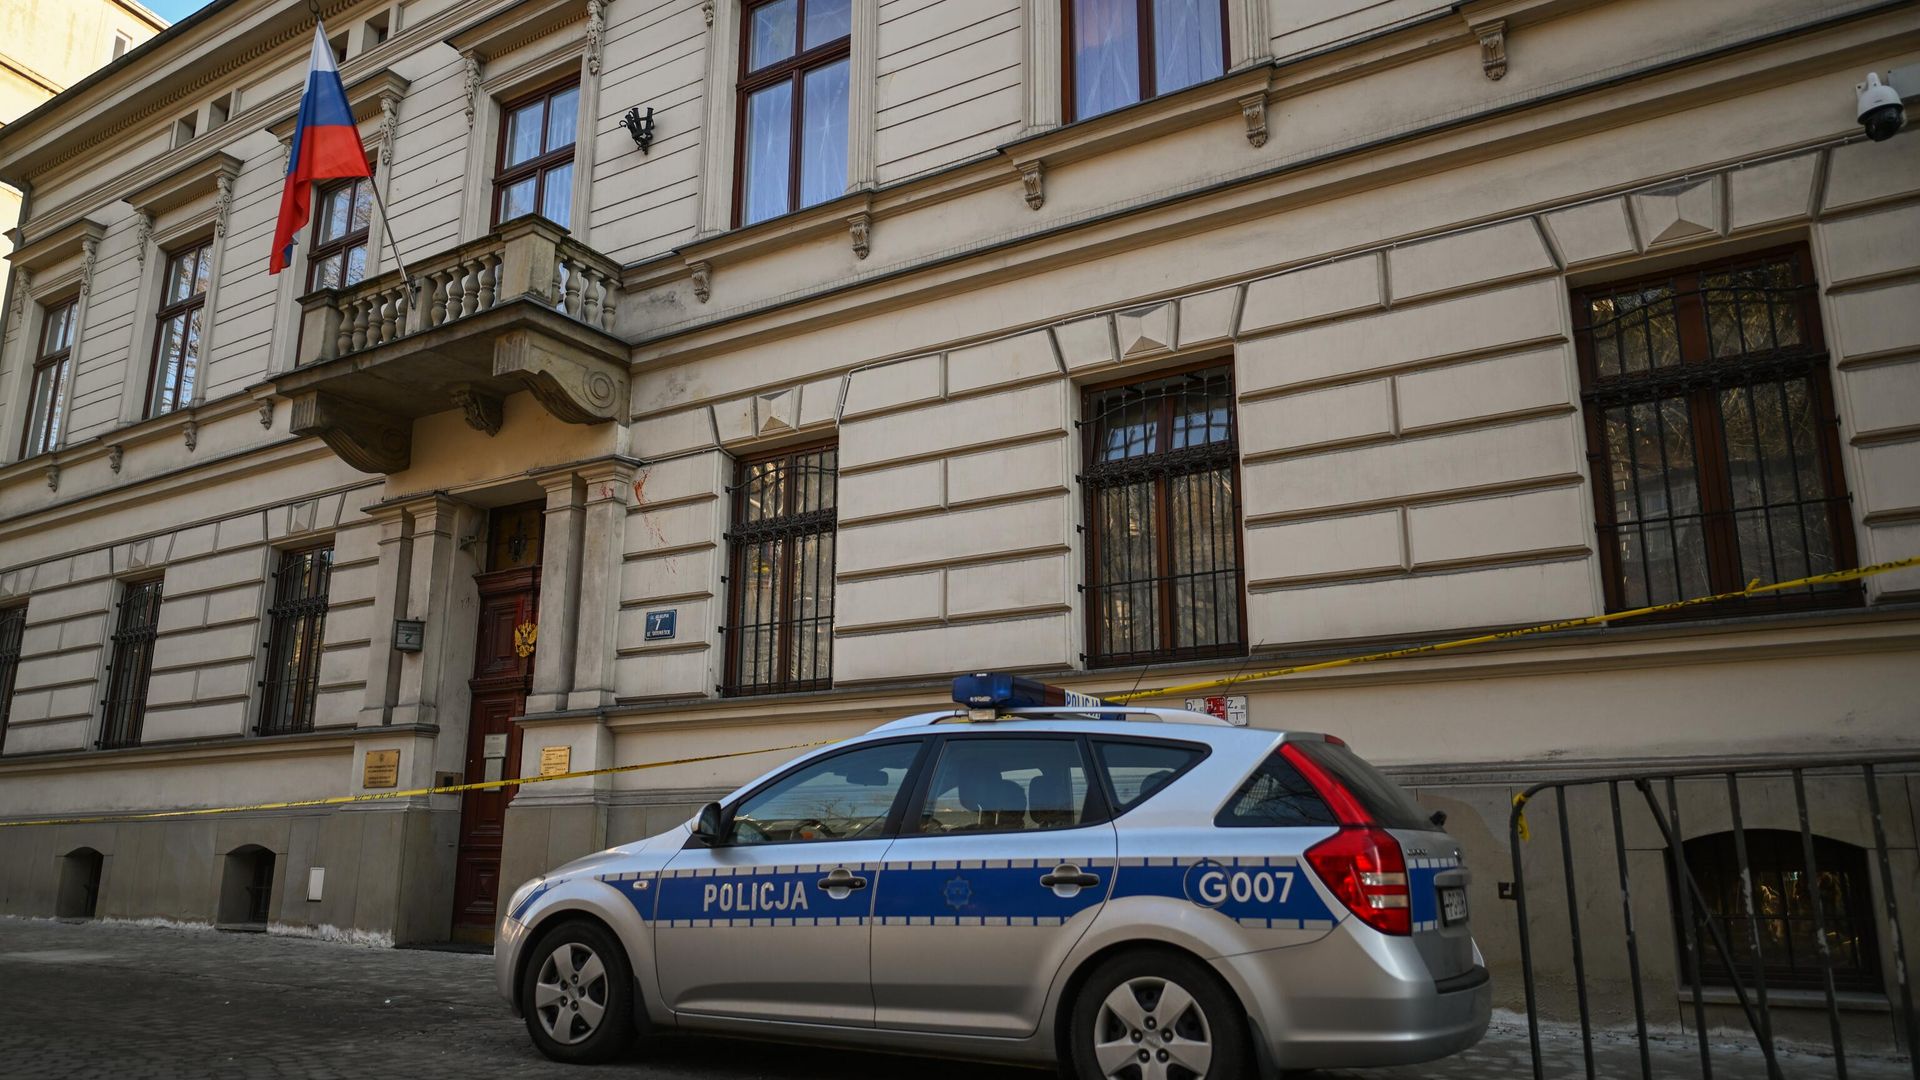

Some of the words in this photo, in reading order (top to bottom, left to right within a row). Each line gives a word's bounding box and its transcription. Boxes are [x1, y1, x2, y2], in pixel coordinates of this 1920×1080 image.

[655, 619, 662, 631] 7
[703, 881, 809, 912] POLICJA
[1199, 871, 1294, 904] G007
